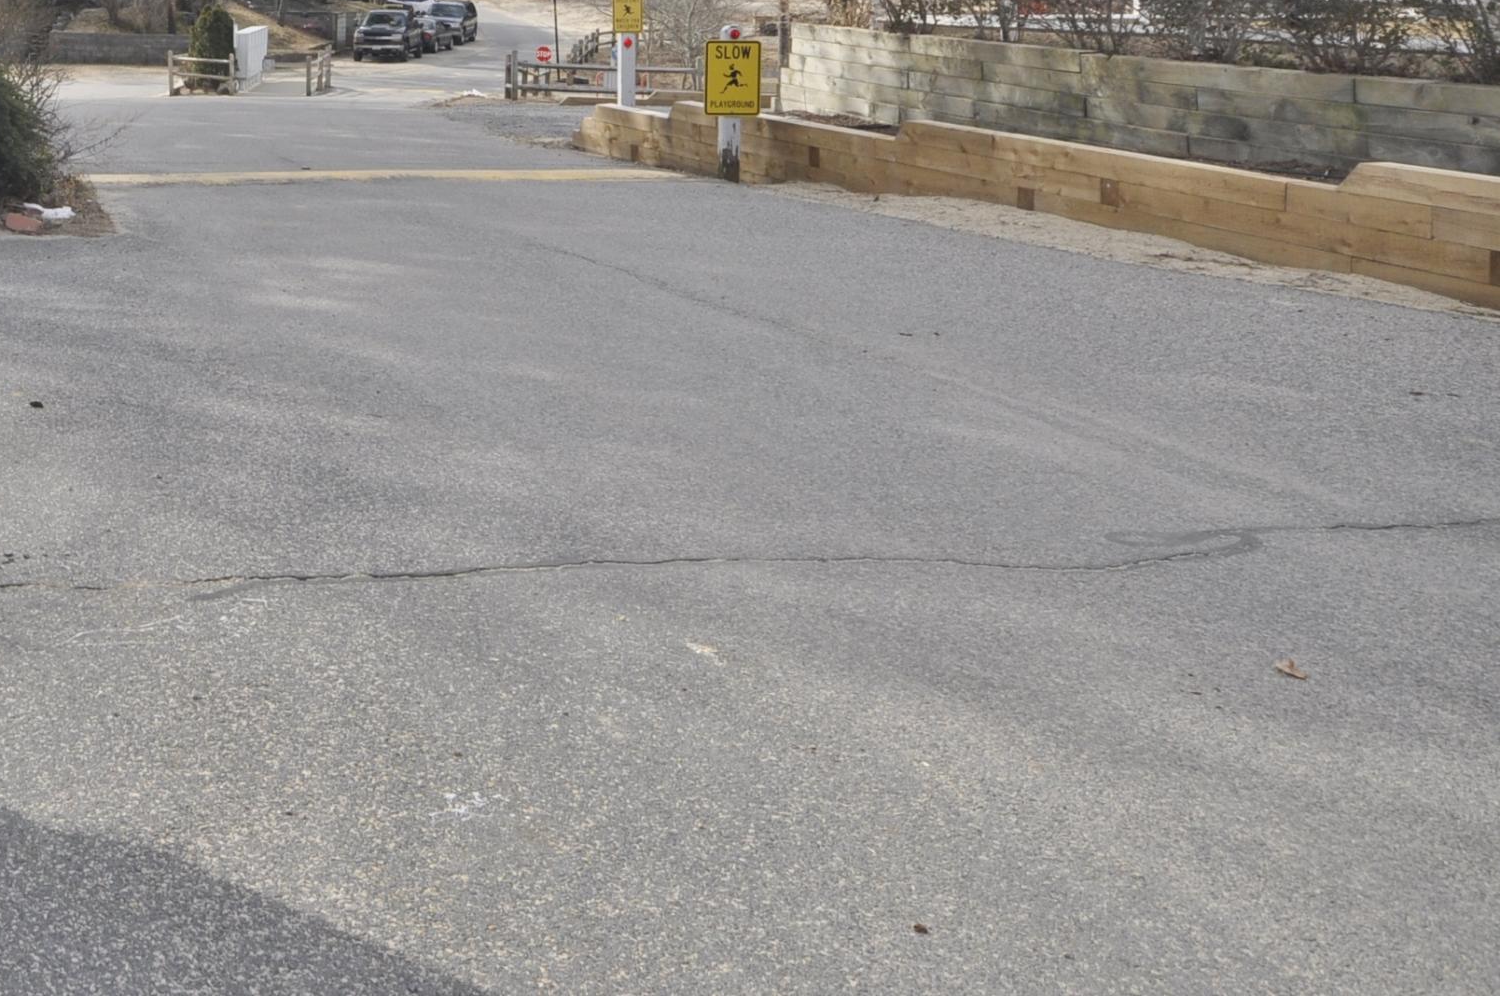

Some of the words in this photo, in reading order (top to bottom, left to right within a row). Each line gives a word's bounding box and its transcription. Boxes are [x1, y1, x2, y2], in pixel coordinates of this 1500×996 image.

[535, 50, 552, 58] STOP
[715, 45, 752, 60] SLOW
[710, 100, 755, 109] PLAYGROUND
